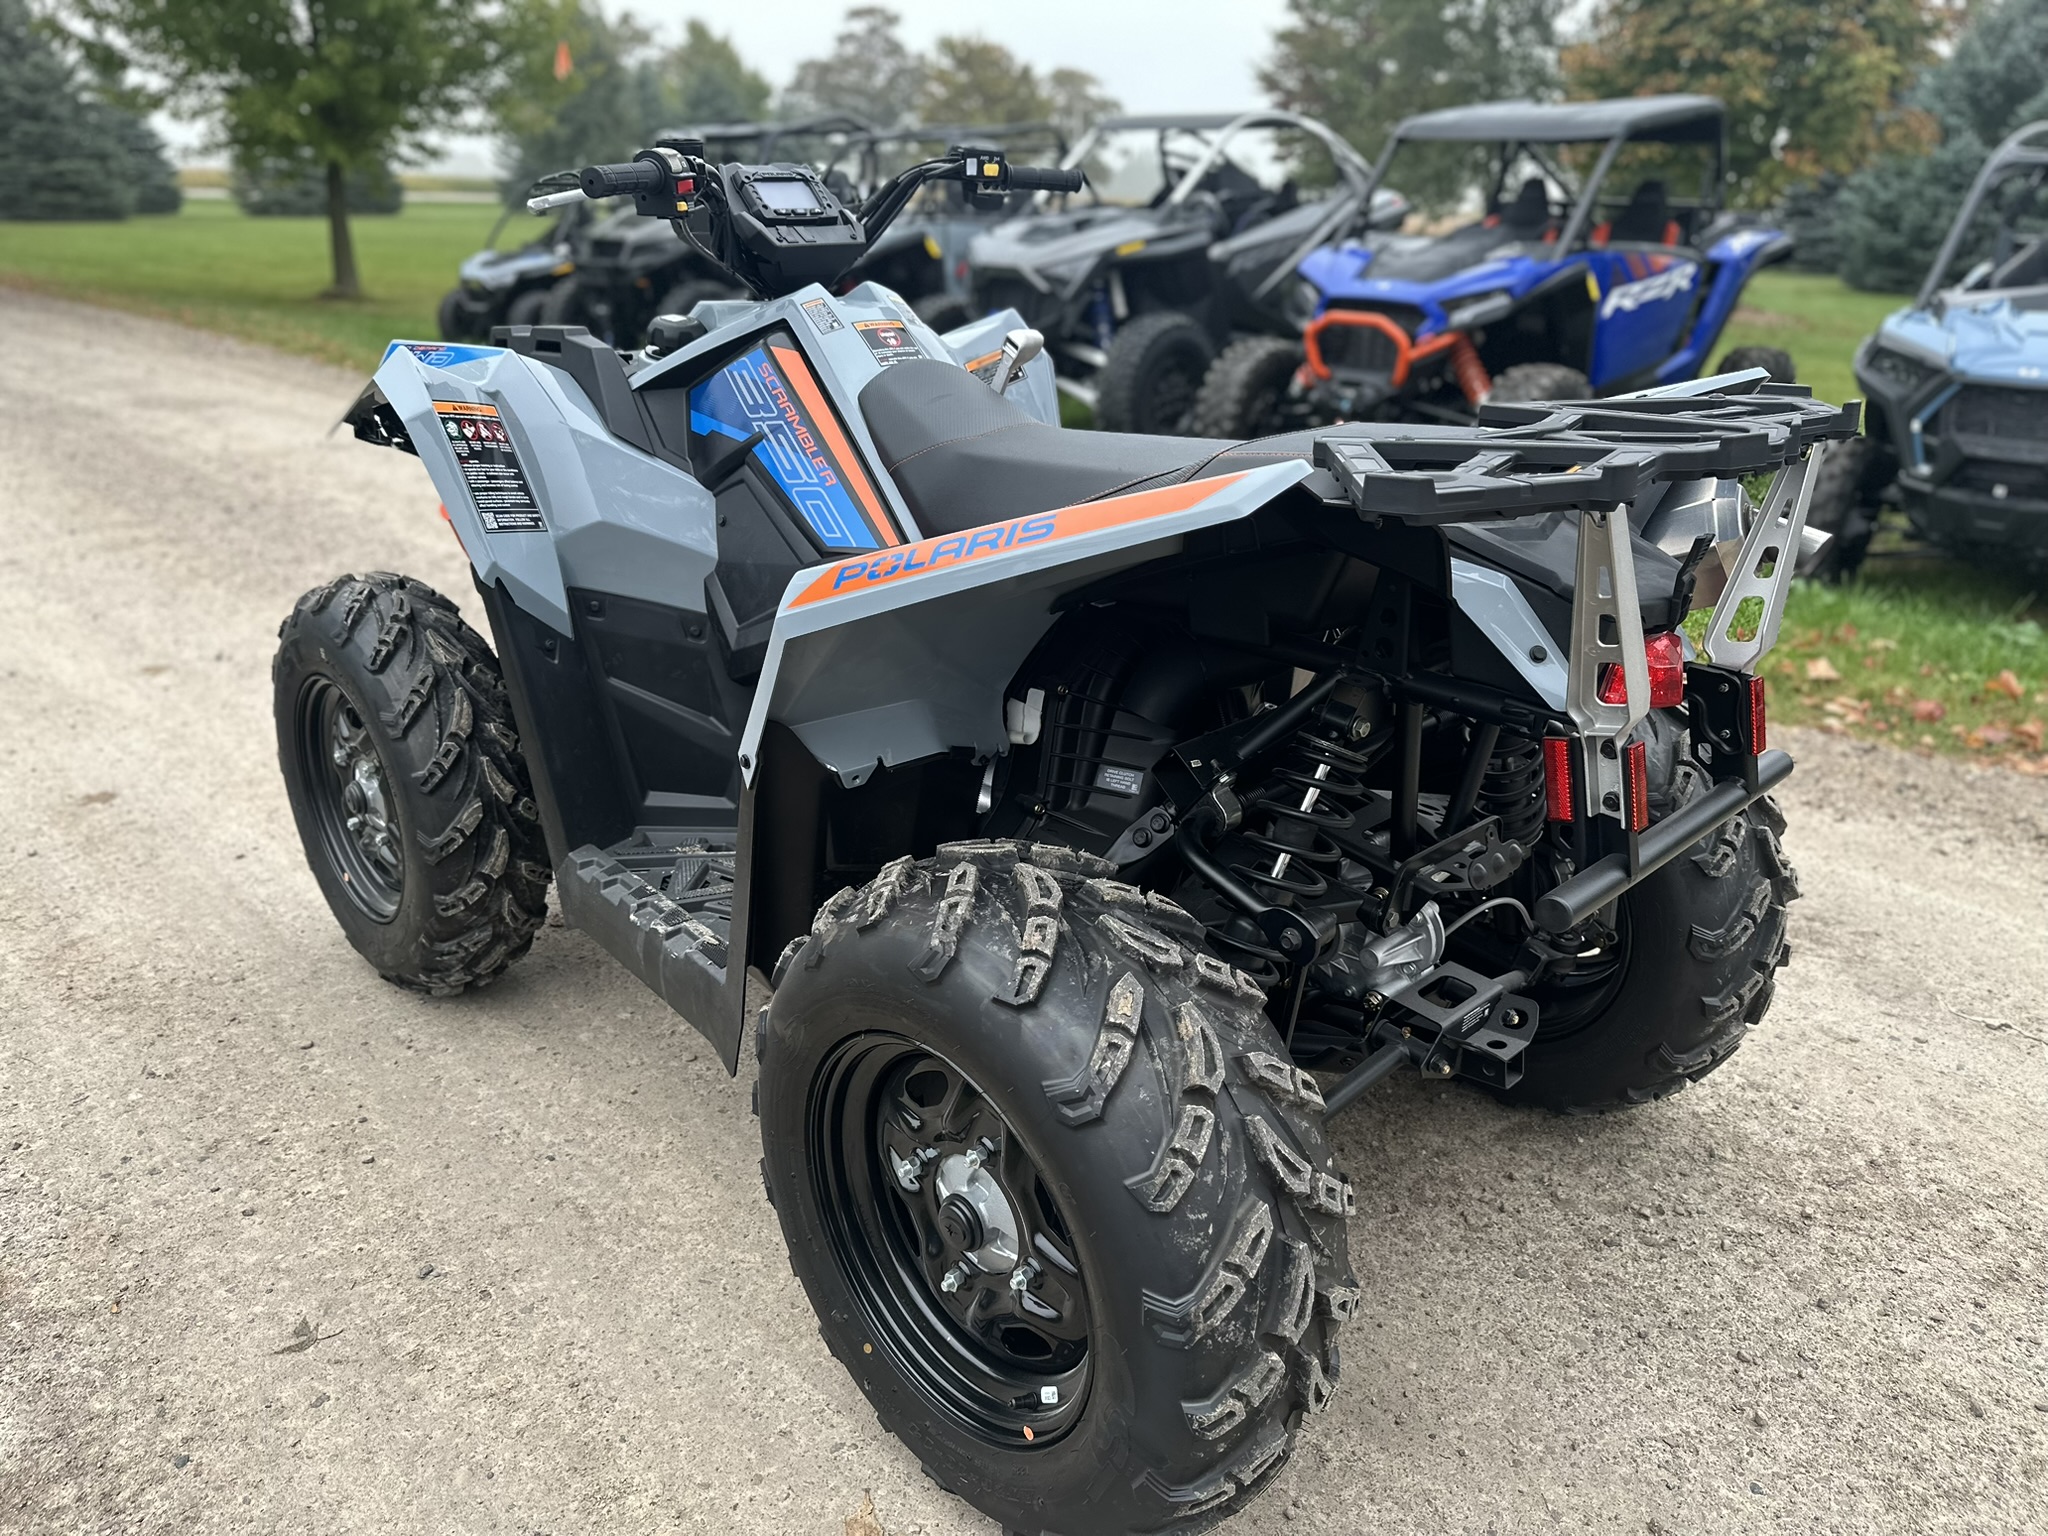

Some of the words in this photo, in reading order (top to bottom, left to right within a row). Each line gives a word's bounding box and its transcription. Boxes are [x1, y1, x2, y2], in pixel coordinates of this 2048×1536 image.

[1600, 261, 1698, 320] RZR
[758, 362, 837, 487] SCRAMBLER
[833, 514, 1057, 590] POLARIS
